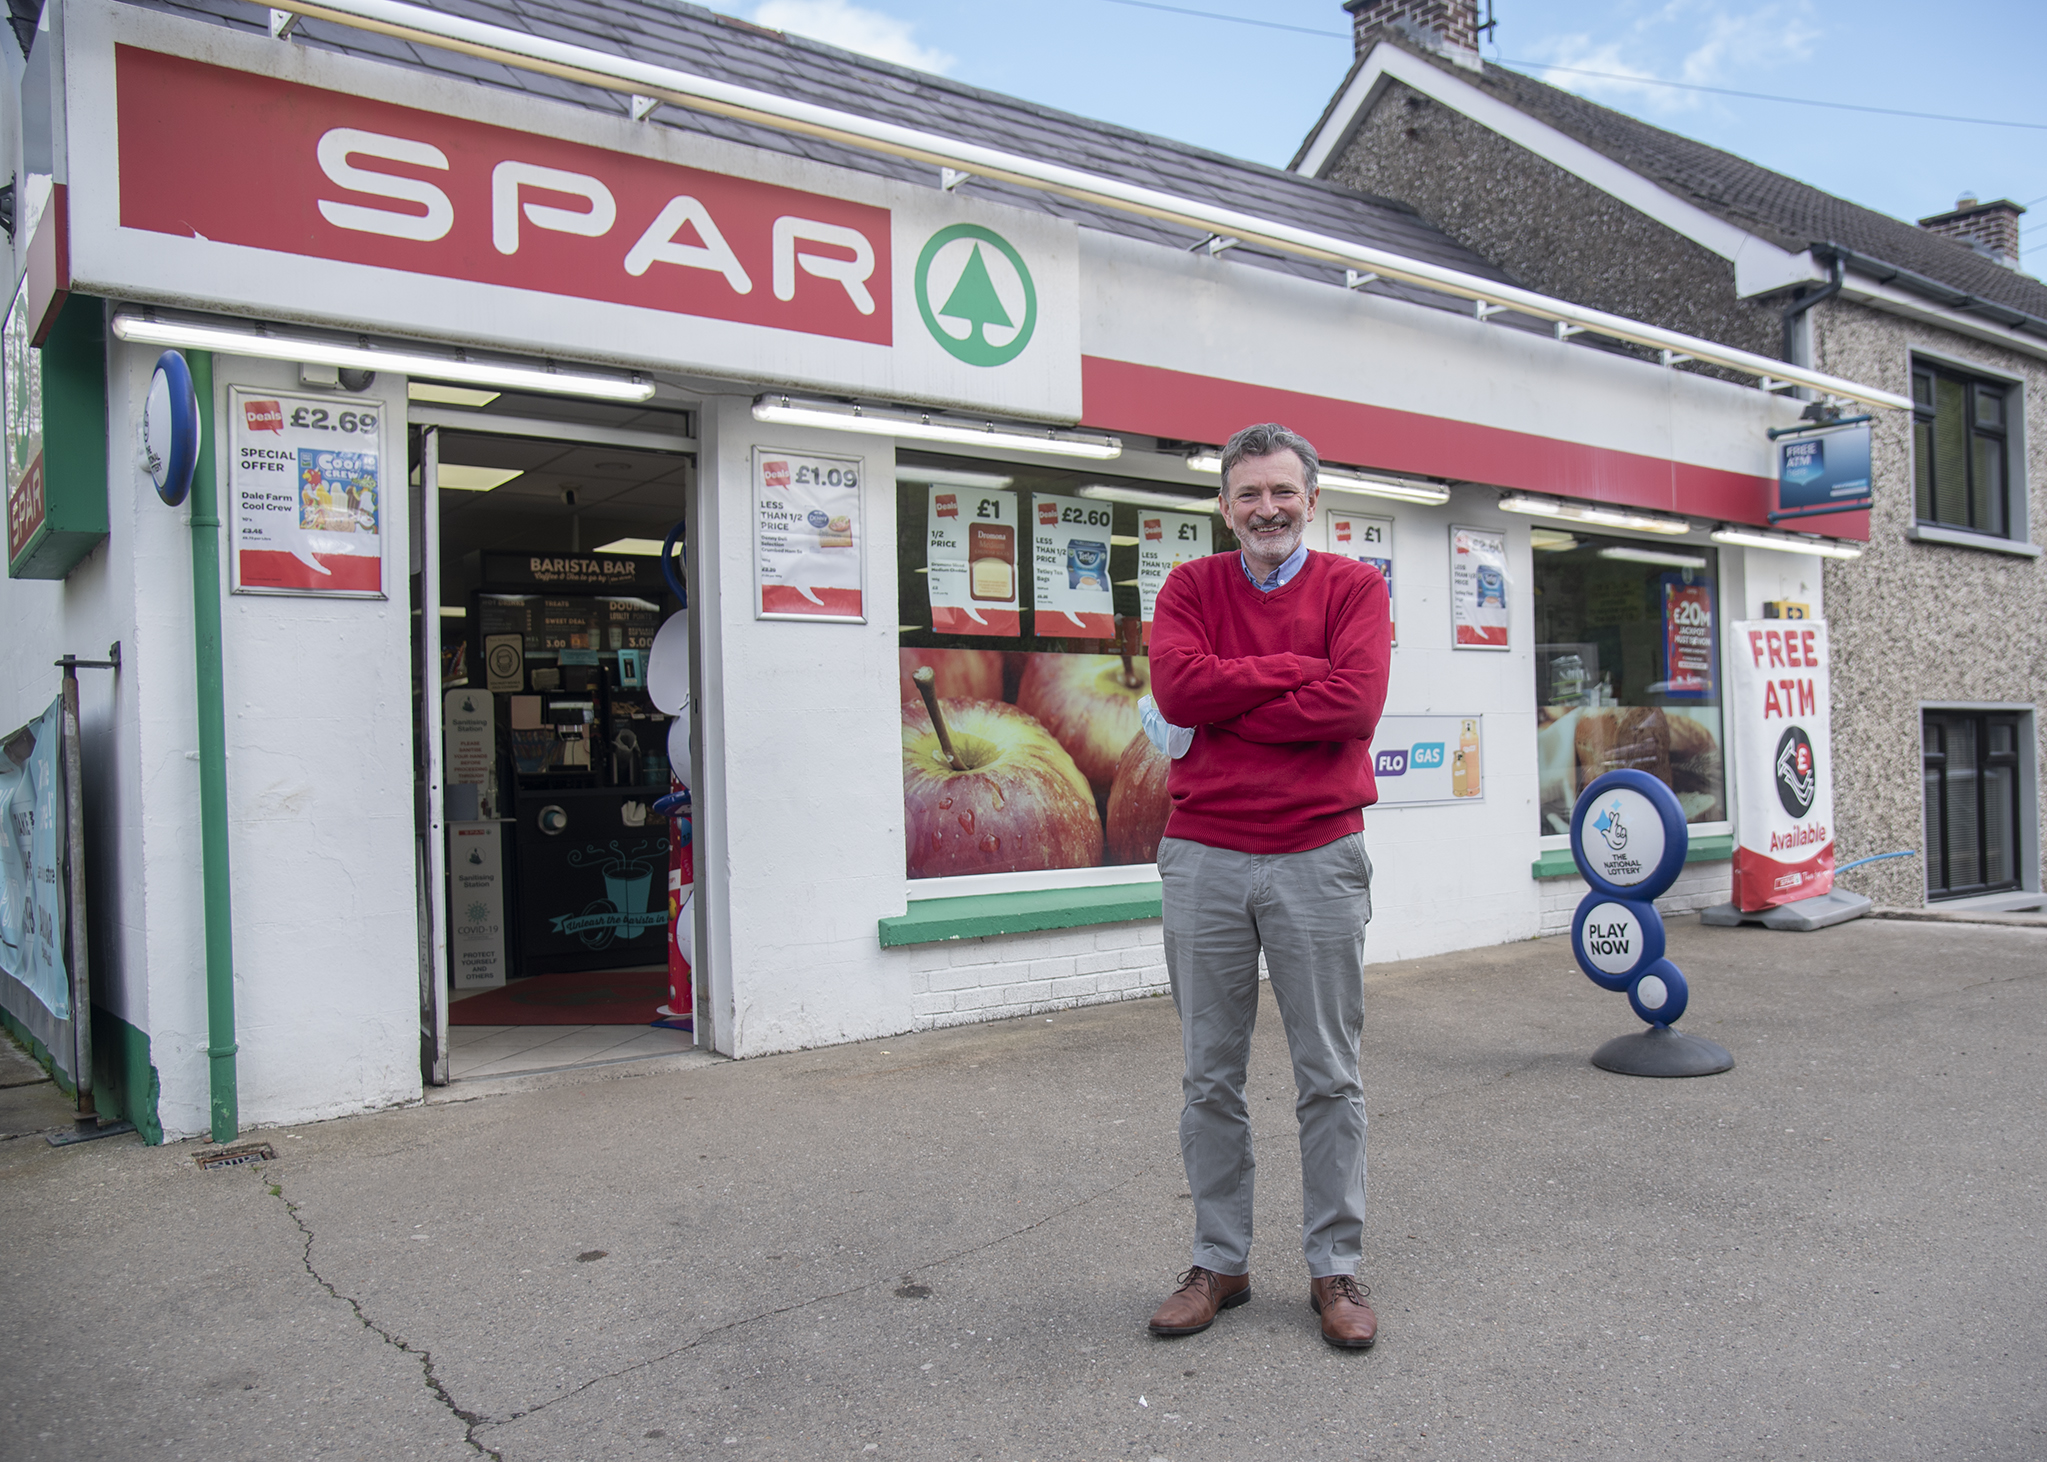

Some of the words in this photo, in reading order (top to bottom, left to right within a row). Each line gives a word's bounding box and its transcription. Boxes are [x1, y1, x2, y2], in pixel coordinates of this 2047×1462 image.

[317, 127, 876, 317] SPAR
[247, 410, 282, 421] Deals
[290, 407, 378, 434] £2.69
[241, 448, 296, 460] SPECIAL
[1786, 442, 1817, 457] FREE
[241, 461, 284, 472] OFFER
[318, 453, 360, 470] Cool
[1786, 455, 1812, 468] ATM
[325, 470, 359, 479] CREW
[765, 468, 790, 479] Deals
[795, 465, 858, 489] £1.09
[242, 491, 264, 501] Dale
[266, 493, 293, 502] Farm
[12, 467, 42, 547] SPAR
[242, 502, 264, 511] Cool
[266, 503, 293, 512] Crew
[761, 501, 784, 510] LESS
[936, 502, 958, 510] Deals
[977, 498, 1000, 519] £1
[761, 511, 787, 520] THAN
[789, 513, 803, 522] 1/2
[1038, 511, 1058, 519] Deals
[1061, 506, 1110, 527] £2.60
[761, 522, 789, 531] PRICE
[1144, 526, 1162, 534] Deals
[1178, 523, 1197, 541] £1
[931, 530, 944, 539] 1/2
[977, 530, 1007, 540] Dromona
[1364, 526, 1381, 543] £1
[931, 540, 957, 548] PRICE
[1036, 537, 1053, 545] LESS
[1036, 546, 1056, 554] THAN
[1057, 548, 1067, 557] 1/2
[1078, 551, 1096, 563] Tetley
[1036, 555, 1057, 563] PRICE
[530, 557, 600, 573] BARISTA
[603, 560, 636, 576] BAR
[1141, 560, 1160, 568] THAN
[1161, 562, 1171, 570] 1/2
[533, 572, 558, 582] Coffee
[588, 574, 597, 583] go
[598, 573, 607, 583] by
[1037, 568, 1053, 576] Tetley
[1141, 569, 1161, 577] PRICE
[1673, 600, 1712, 627] £20M
[1679, 626, 1706, 635] JACKPOT
[546, 640, 566, 648] 3.00
[628, 637, 653, 648] 3.00
[1674, 635, 1689, 644] MUST
[1748, 630, 1819, 669] FREE
[1764, 679, 1816, 720] ATM
[1379, 756, 1404, 771] FLO
[1415, 748, 1440, 763] GAS
[1770, 822, 1826, 852] Available
[1603, 860, 1641, 869] NATIONAL
[1607, 867, 1640, 876] LOTTERY
[458, 874, 494, 882] Sanitising
[566, 917, 605, 931] Unleash
[606, 915, 624, 924] the
[623, 915, 654, 924] barista
[655, 914, 666, 923] in
[457, 925, 499, 934] COVID-19
[1589, 923, 1629, 939] PLAY
[1590, 939, 1630, 955] NOW
